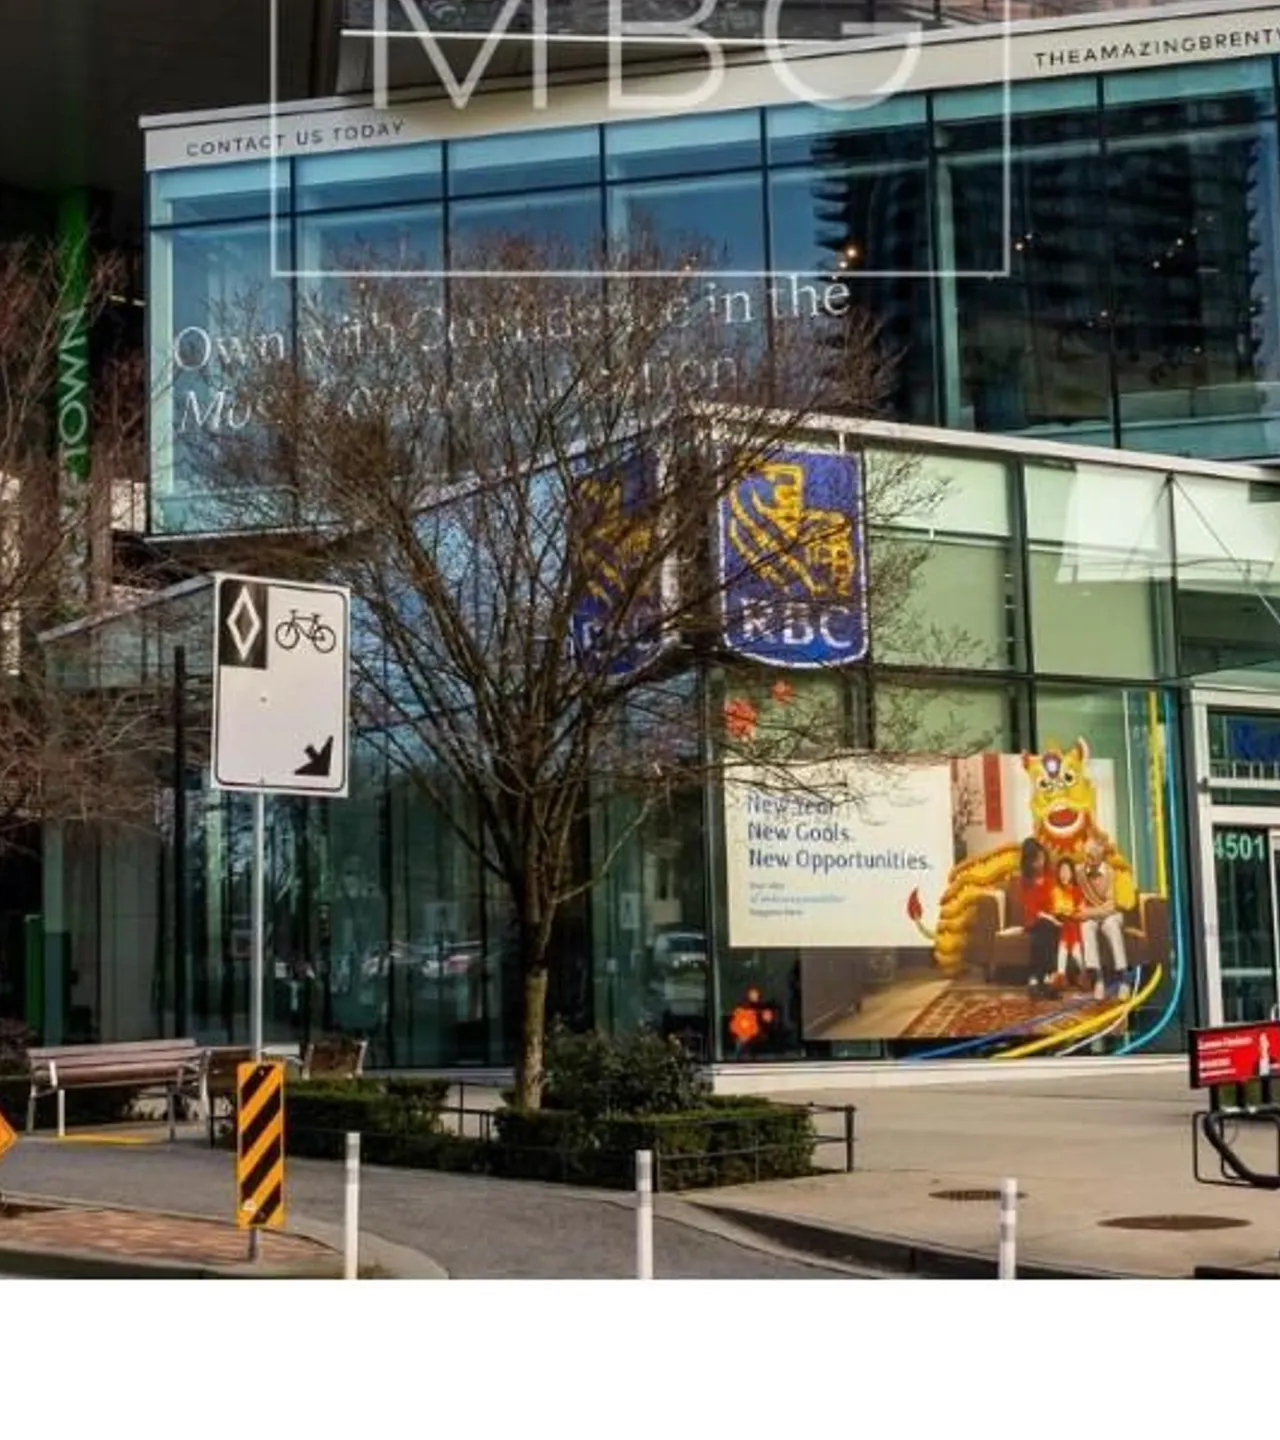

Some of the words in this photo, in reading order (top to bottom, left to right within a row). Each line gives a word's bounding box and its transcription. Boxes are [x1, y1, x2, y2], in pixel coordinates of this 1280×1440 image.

[186, 133, 286, 157] CONTACT
[296, 128, 324, 146] US
[333, 118, 405, 142] TODAY
[174, 326, 285, 372] Own
[703, 281, 755, 325] in
[769, 272, 851, 318] the
[740, 597, 853, 649] RBC
[748, 822, 788, 842] New
[749, 849, 789, 868] New
